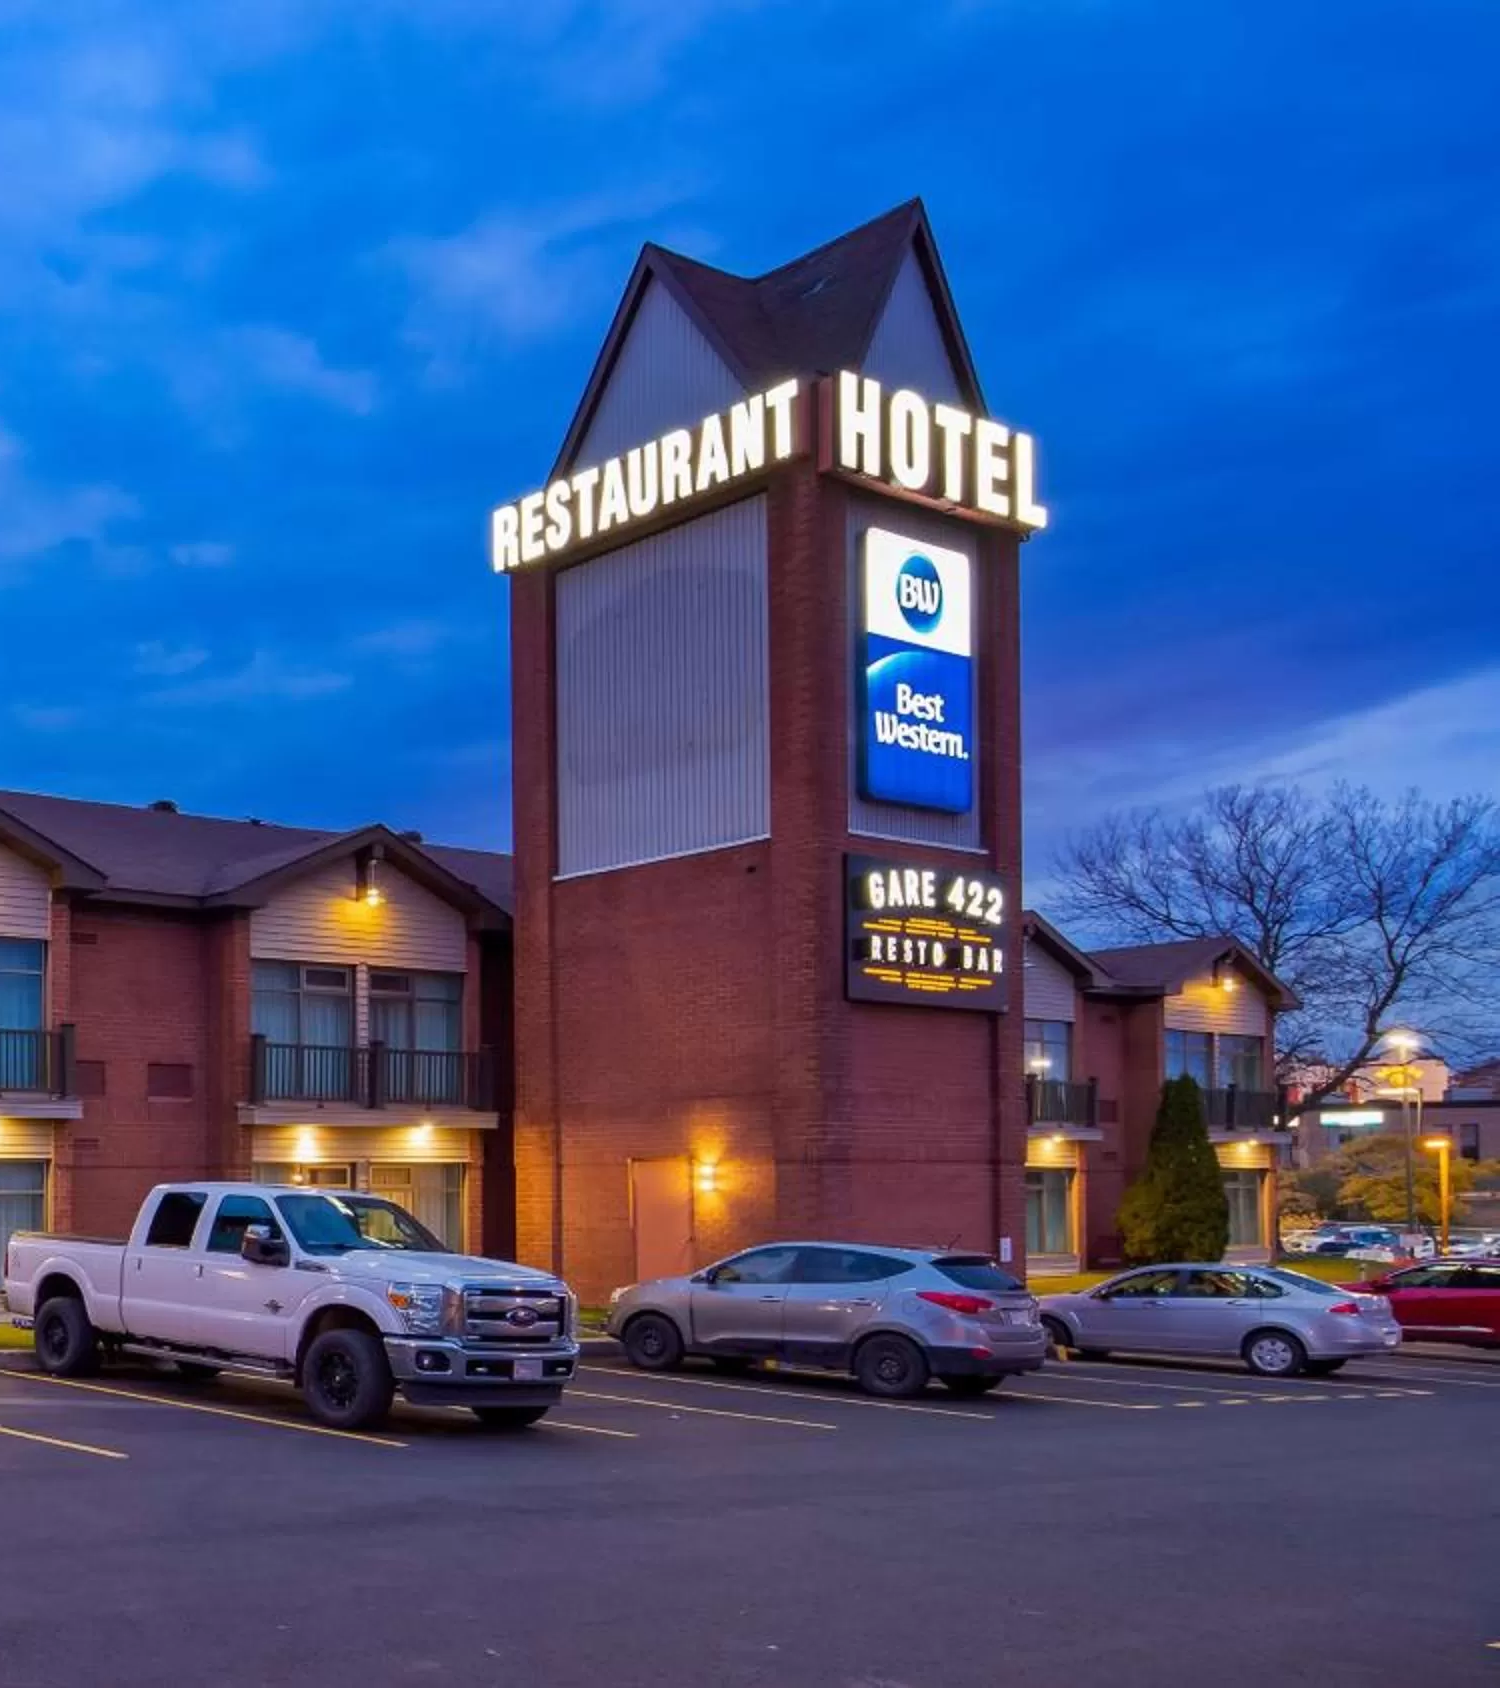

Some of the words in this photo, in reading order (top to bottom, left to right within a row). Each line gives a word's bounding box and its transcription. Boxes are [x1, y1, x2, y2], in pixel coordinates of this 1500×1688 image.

[838, 369, 1049, 530] HOTEL
[492, 378, 799, 574] RESTAURANT
[900, 573, 940, 615] BW
[896, 682, 945, 723] Best
[867, 868, 937, 910] GARE
[947, 876, 1003, 925] 422
[871, 935, 946, 967] RESTO
[963, 945, 1003, 973] BAR
